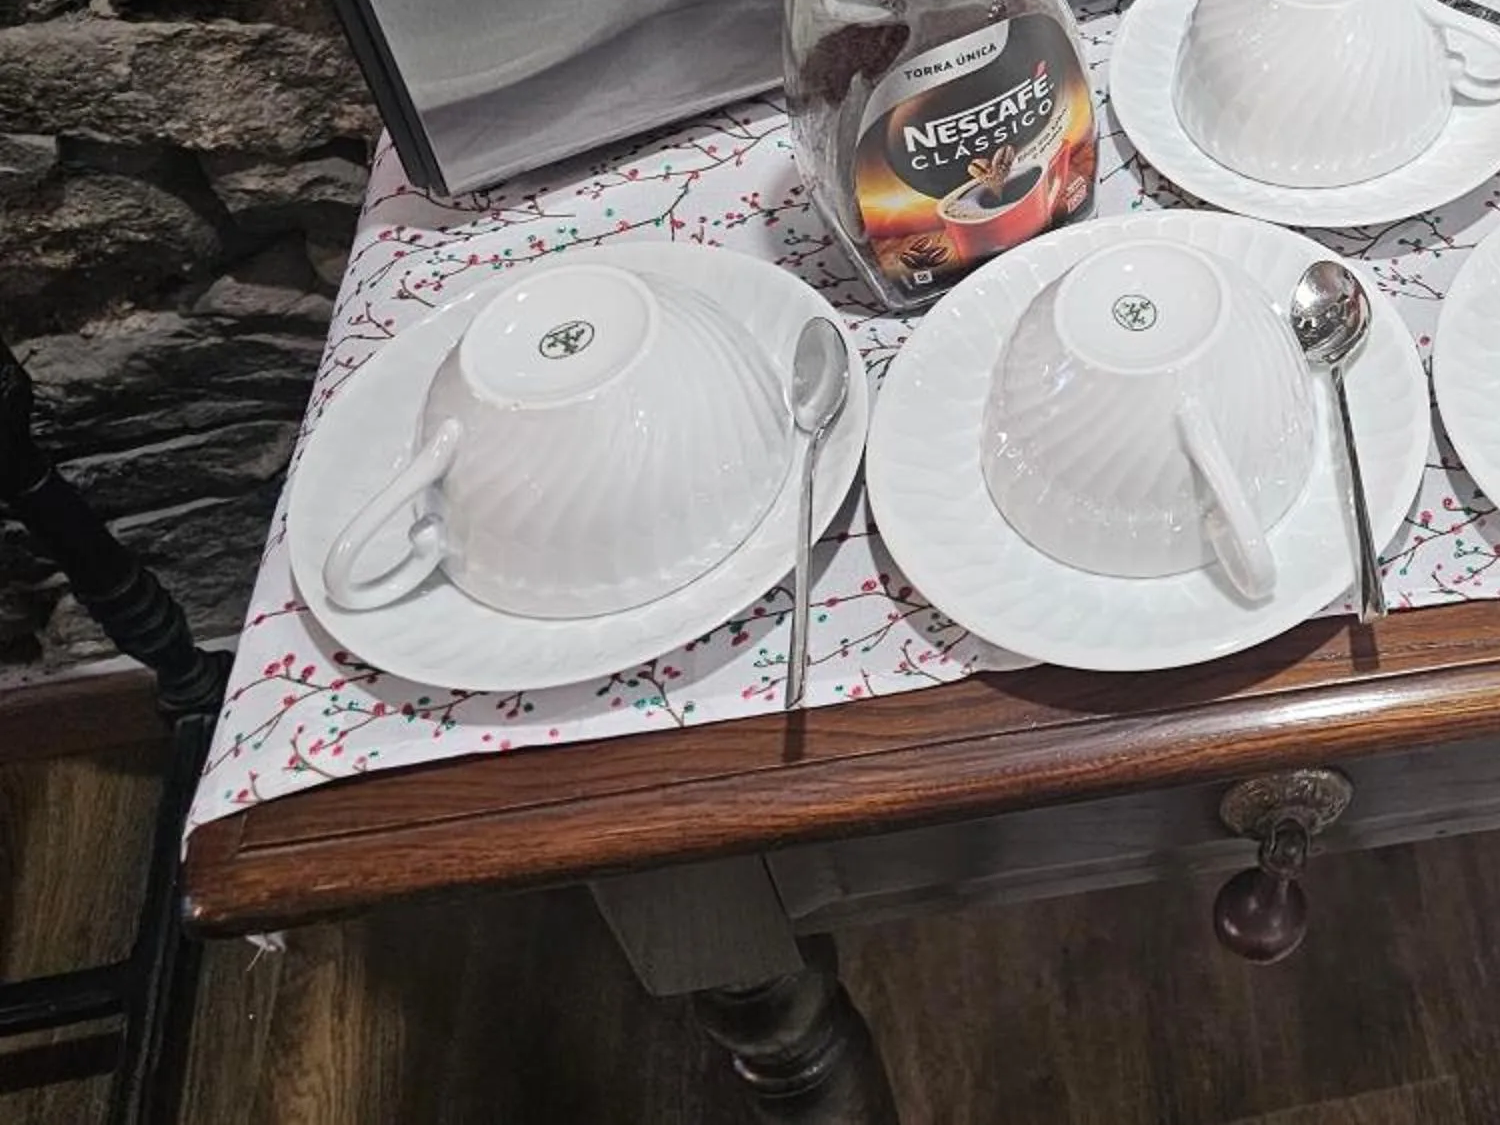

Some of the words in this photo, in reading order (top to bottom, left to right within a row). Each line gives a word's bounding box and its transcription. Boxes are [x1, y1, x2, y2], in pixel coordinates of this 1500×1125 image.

[903, 61, 953, 80] TORRA
[955, 42, 998, 66] ÚNICA
[903, 59, 1050, 153] NESCAFÉ
[911, 98, 1053, 171] CLÁSSICO
